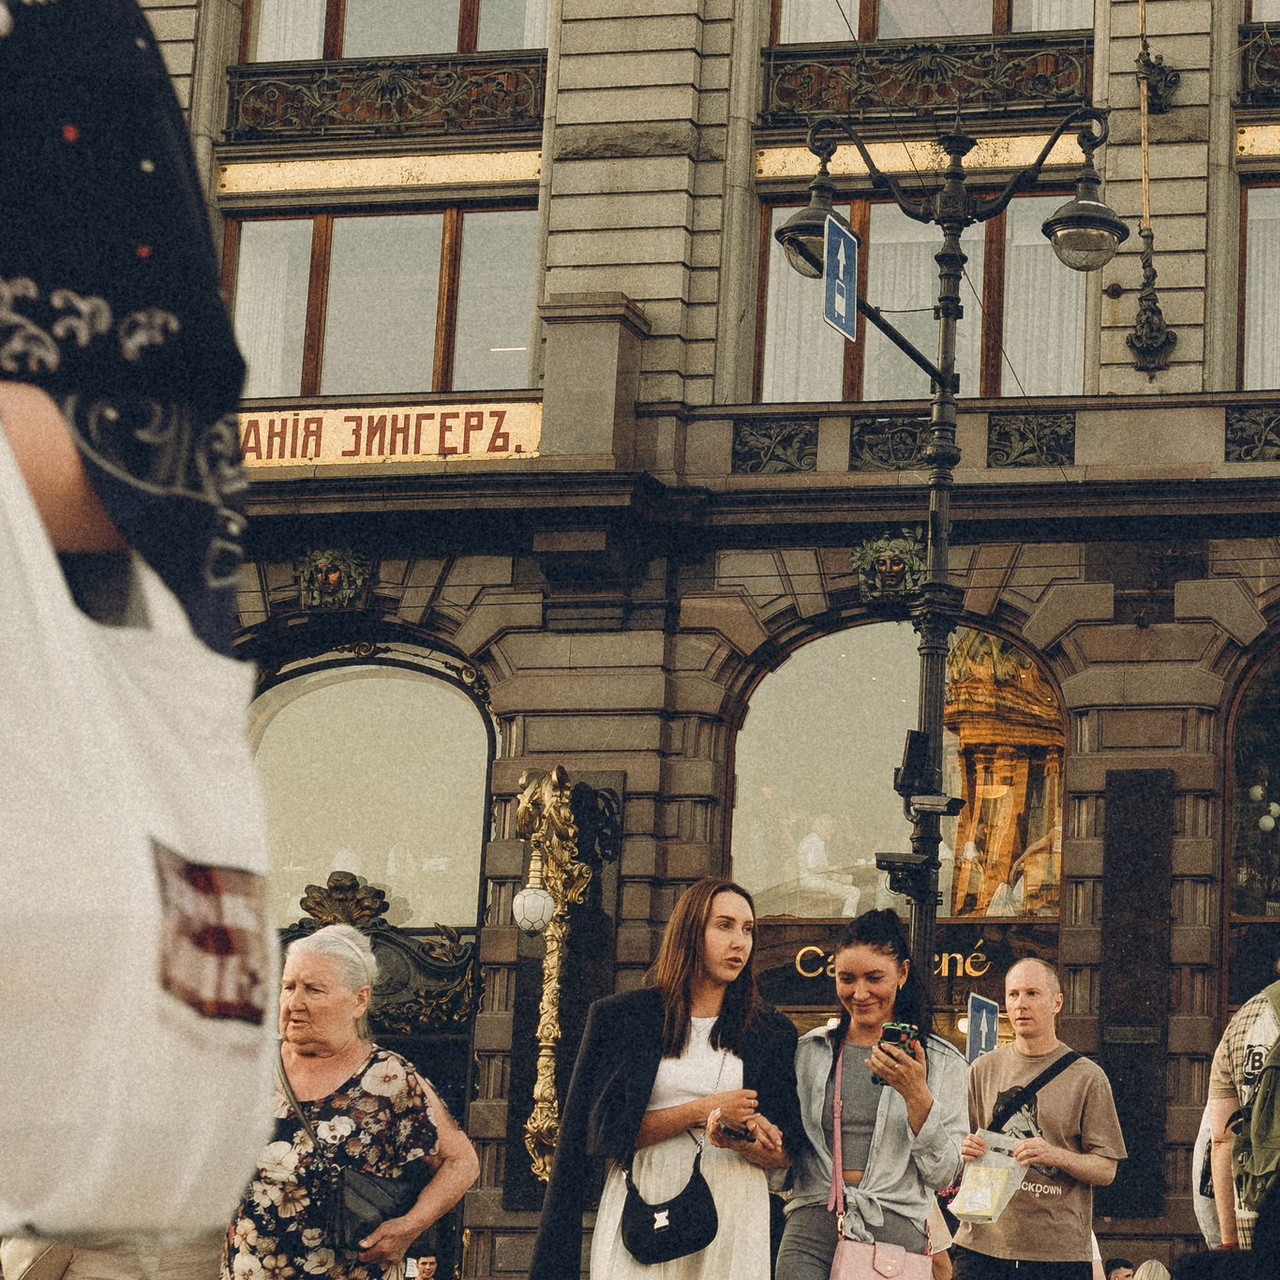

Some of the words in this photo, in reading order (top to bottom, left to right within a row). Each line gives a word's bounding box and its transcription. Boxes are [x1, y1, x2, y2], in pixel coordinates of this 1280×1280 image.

[241, 413, 323, 460] АНІЯ
[341, 410, 522, 457] ЗИНГЕРЪ.
[1018, 1181, 1062, 1195] CKDOWN
